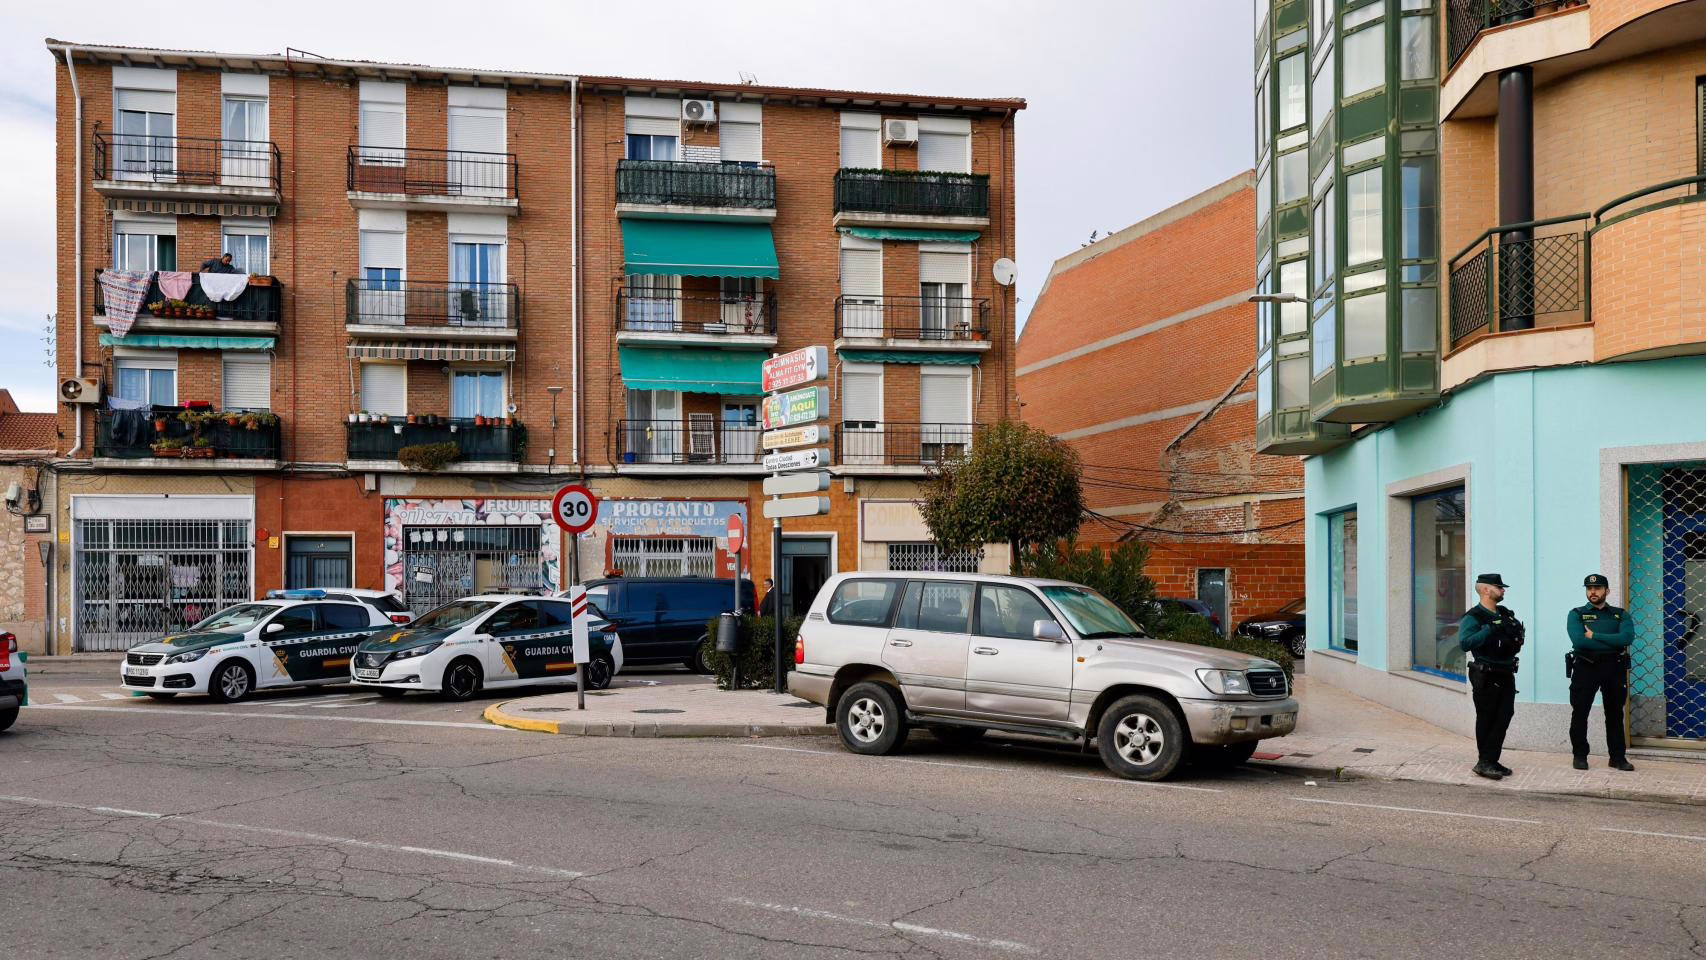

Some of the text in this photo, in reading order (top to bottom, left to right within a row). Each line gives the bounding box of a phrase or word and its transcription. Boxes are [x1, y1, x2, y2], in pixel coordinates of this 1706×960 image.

[773, 351, 806, 369] GIMNASIO
[769, 362, 806, 379] ALMA FIT GYM
[779, 455, 793, 463] Ciudad
[777, 461, 801, 470] Direcciones
[563, 500, 588, 517] 30
[613, 502, 715, 517] PROGANTO
[668, 517, 727, 526] PODUCTOS
[299, 647, 338, 658] GUARDIA
[525, 647, 560, 656] GUARDIA
